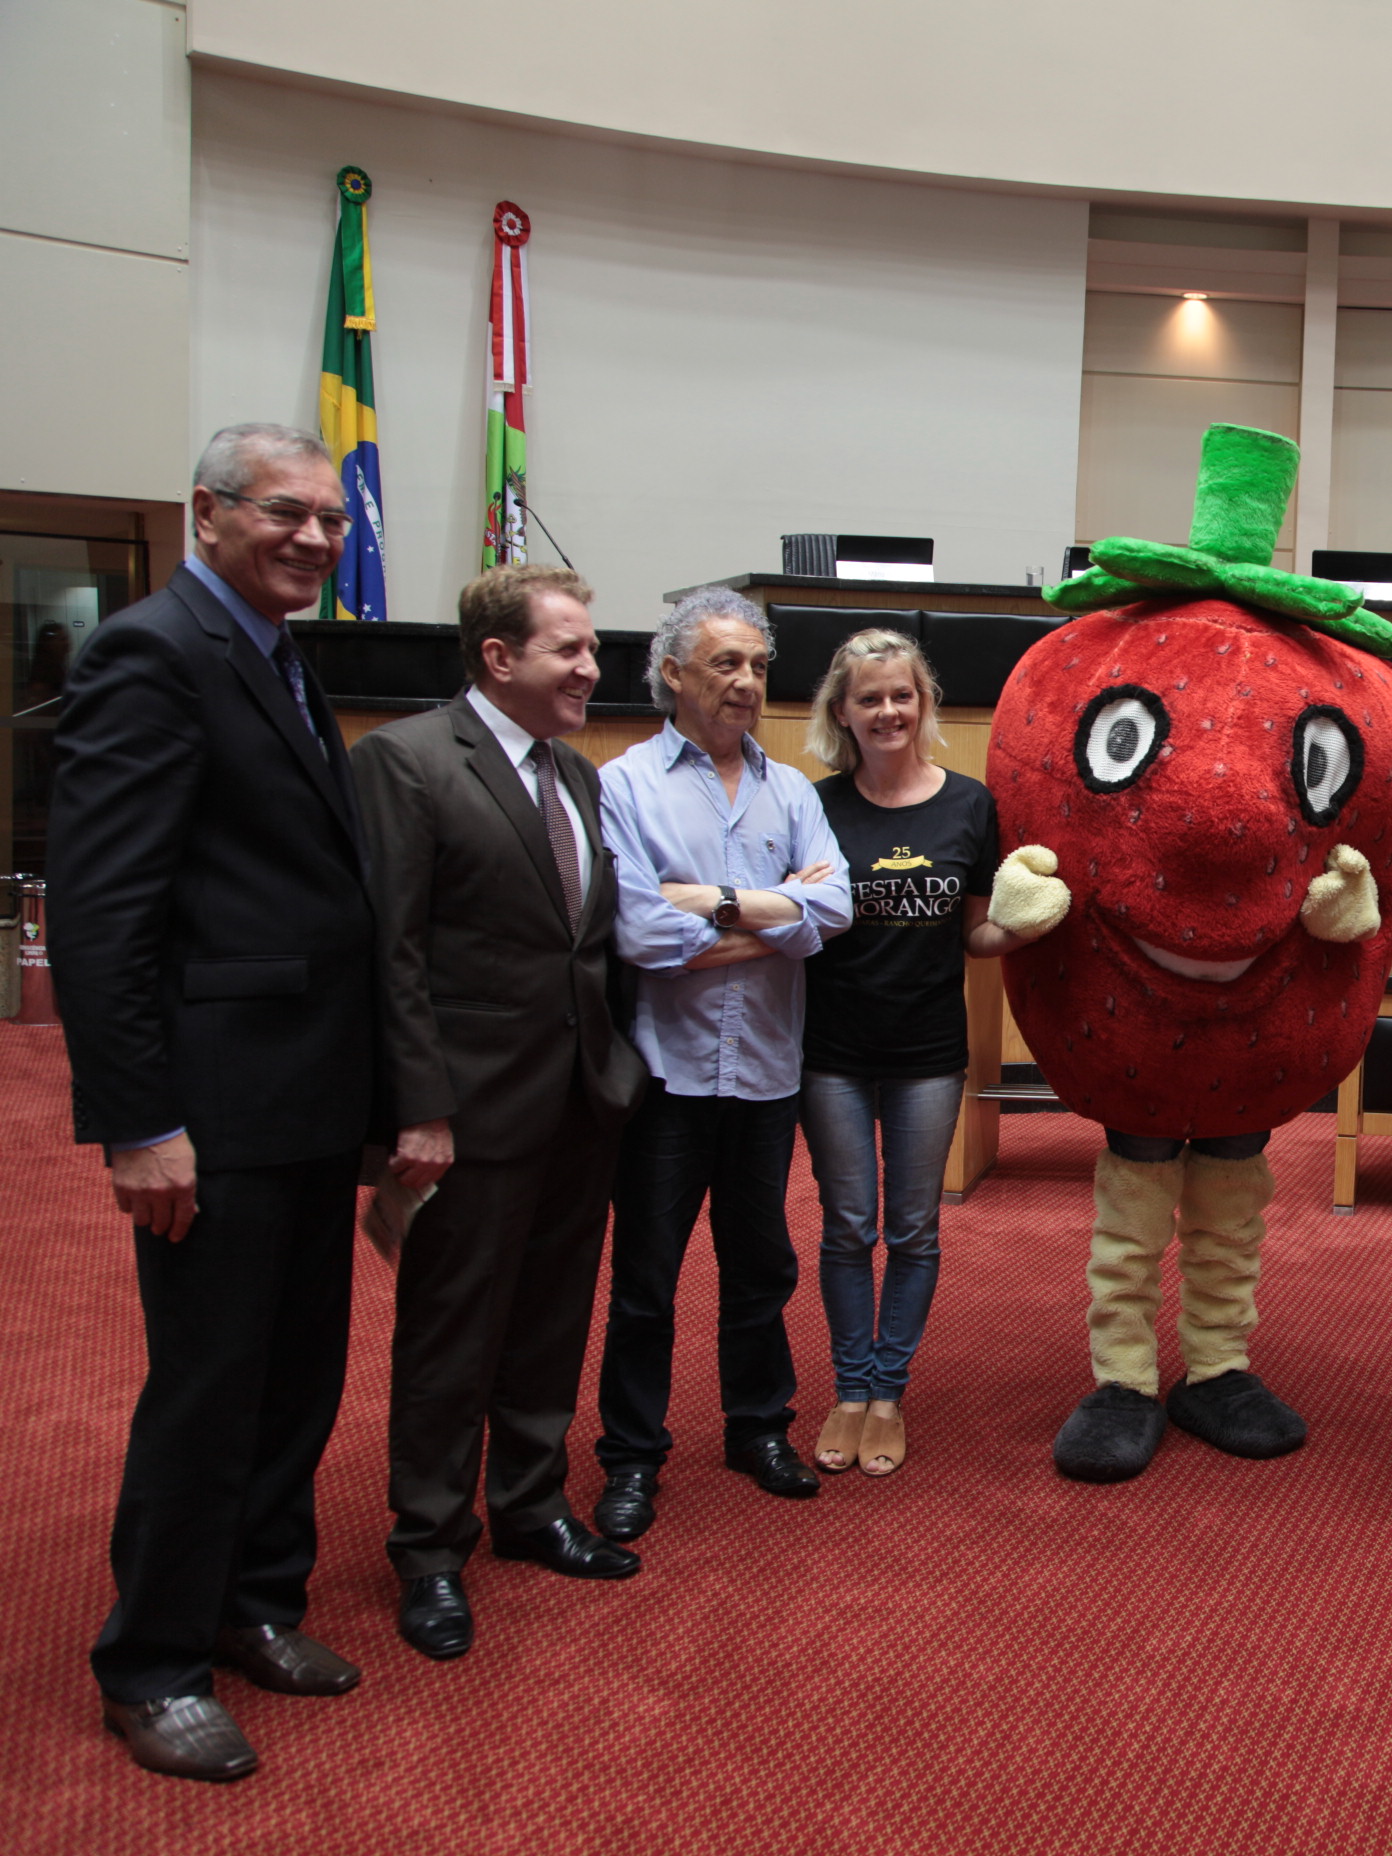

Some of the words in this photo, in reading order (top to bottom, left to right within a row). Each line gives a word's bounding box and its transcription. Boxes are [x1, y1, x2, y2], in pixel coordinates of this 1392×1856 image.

[892, 846, 911, 859] 25
[891, 860, 912, 868] ANOS
[924, 876, 960, 896] DO
[17, 957, 51, 967] PAPEL
